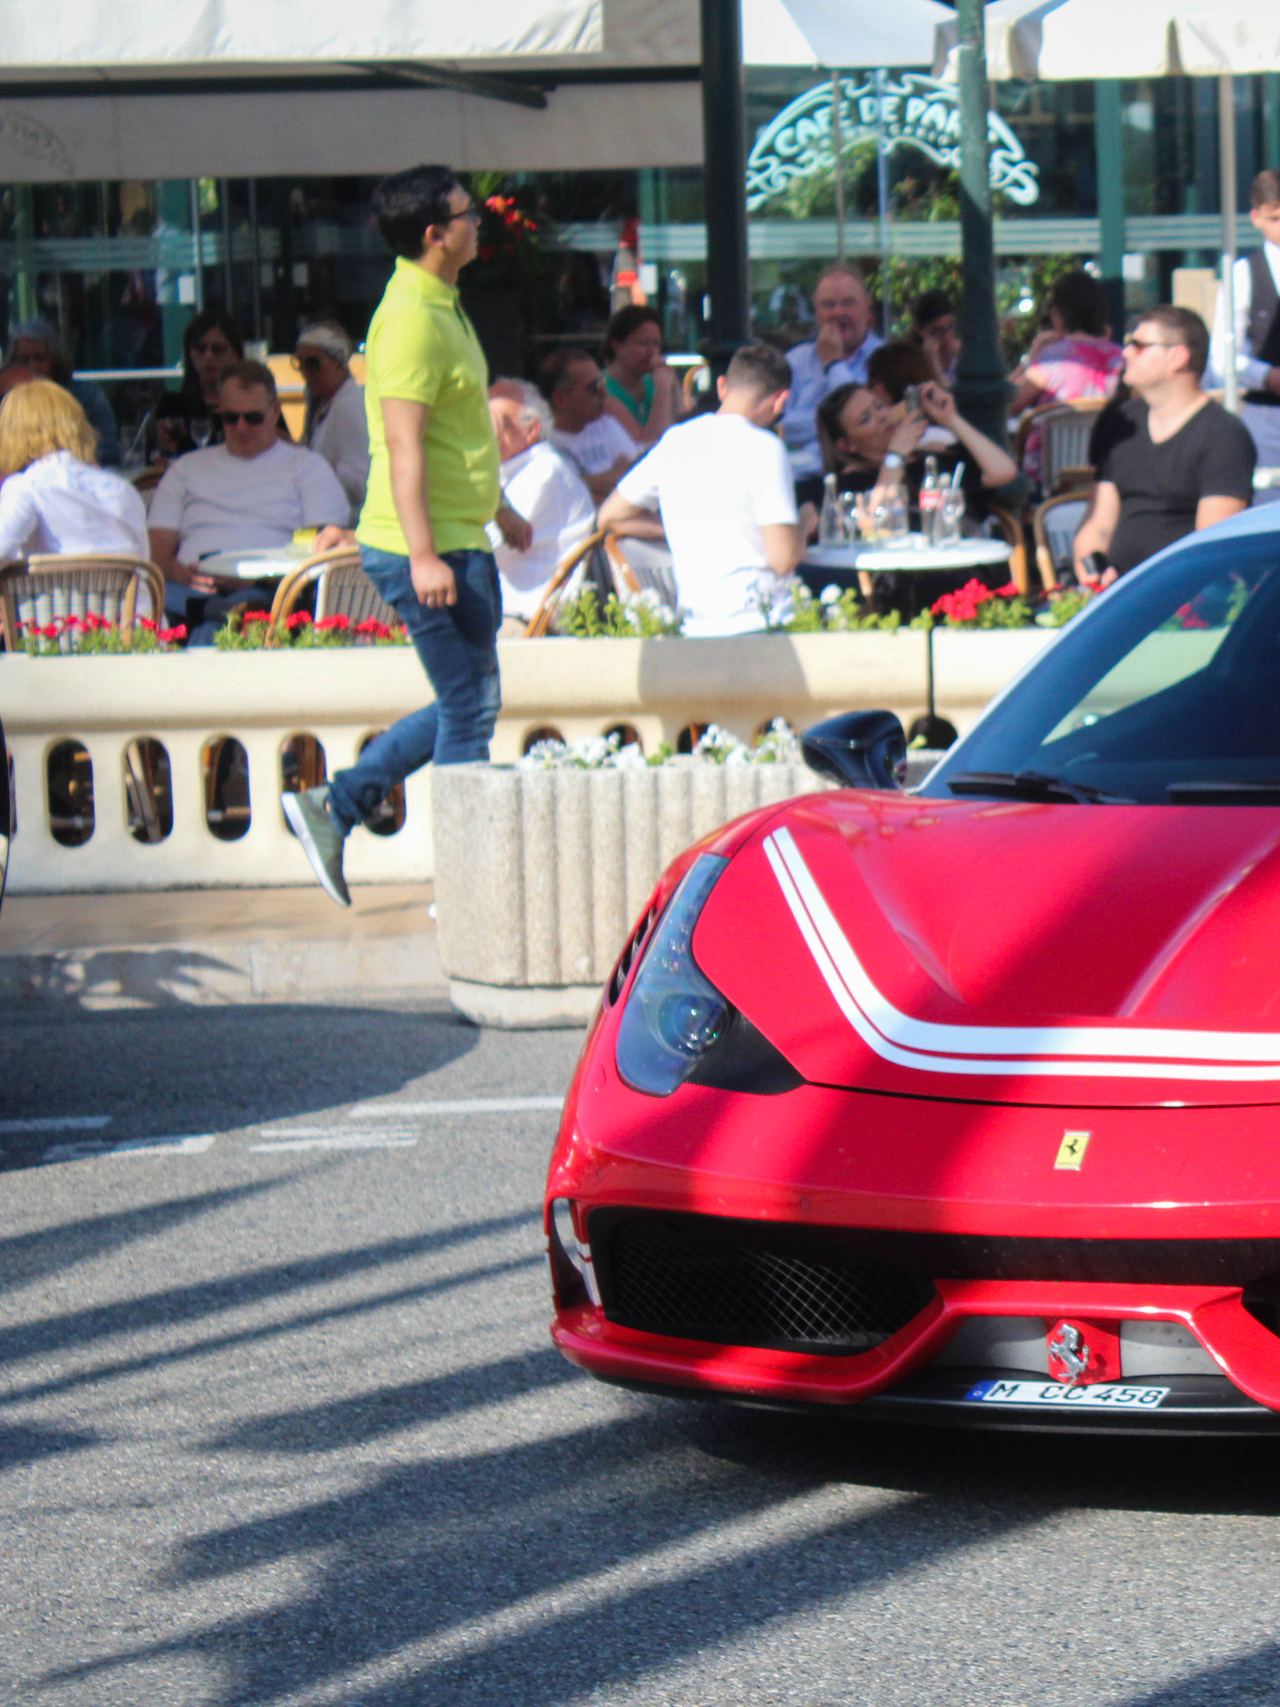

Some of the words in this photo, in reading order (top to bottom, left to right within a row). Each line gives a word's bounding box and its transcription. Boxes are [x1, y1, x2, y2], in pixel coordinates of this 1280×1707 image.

[858, 96, 899, 124] DE
[989, 1384, 1020, 1397] M
[1038, 1386, 1087, 1400] CC
[1093, 1388, 1163, 1404] 458
